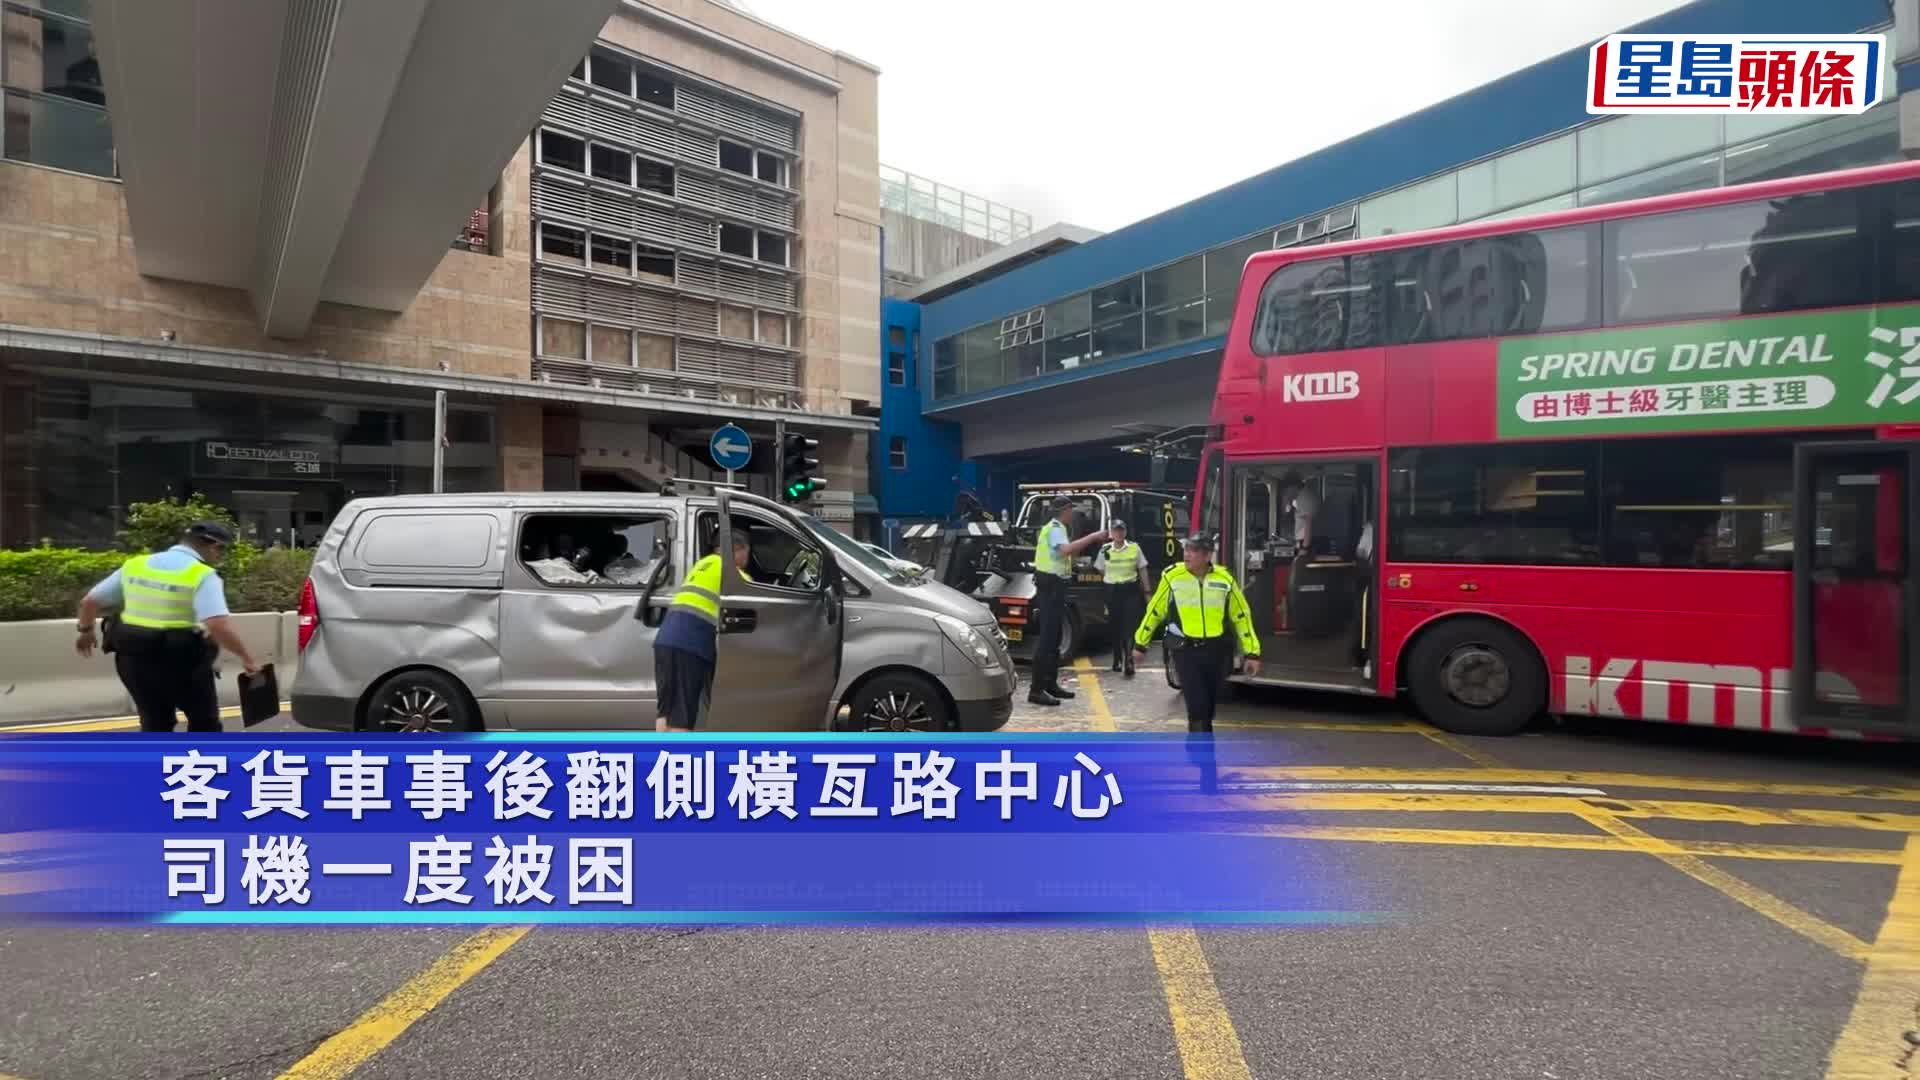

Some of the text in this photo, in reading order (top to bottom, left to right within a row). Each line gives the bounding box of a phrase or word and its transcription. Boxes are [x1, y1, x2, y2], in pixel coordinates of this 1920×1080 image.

[1517, 332, 1834, 382] SPRING DENTAL
[1283, 370, 1360, 403] KMB
[1533, 379, 1808, 418] 由博士級牙醫主理
[228, 446, 284, 459] FESTIVAL
